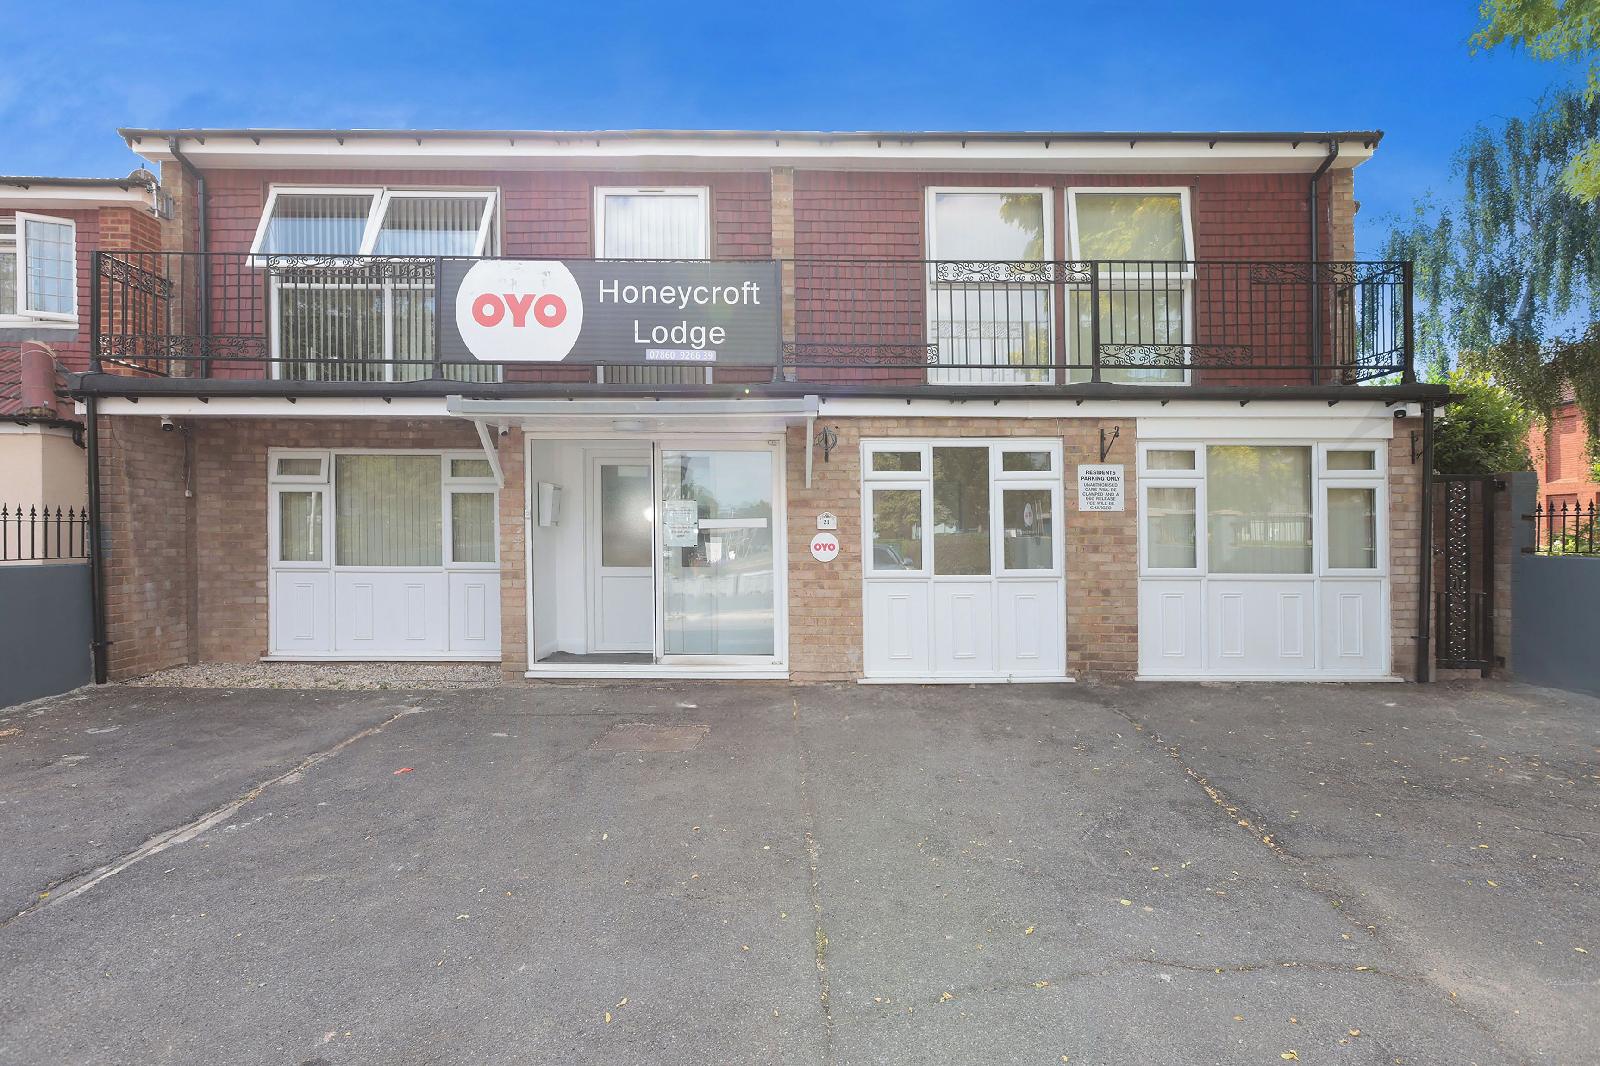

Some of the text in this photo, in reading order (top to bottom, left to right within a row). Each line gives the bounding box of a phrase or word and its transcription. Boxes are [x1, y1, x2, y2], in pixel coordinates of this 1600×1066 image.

[599, 279, 761, 310] Honeycroft
[471, 293, 568, 328] OYO
[634, 319, 727, 349] Lodge
[813, 543, 836, 551] OYO
